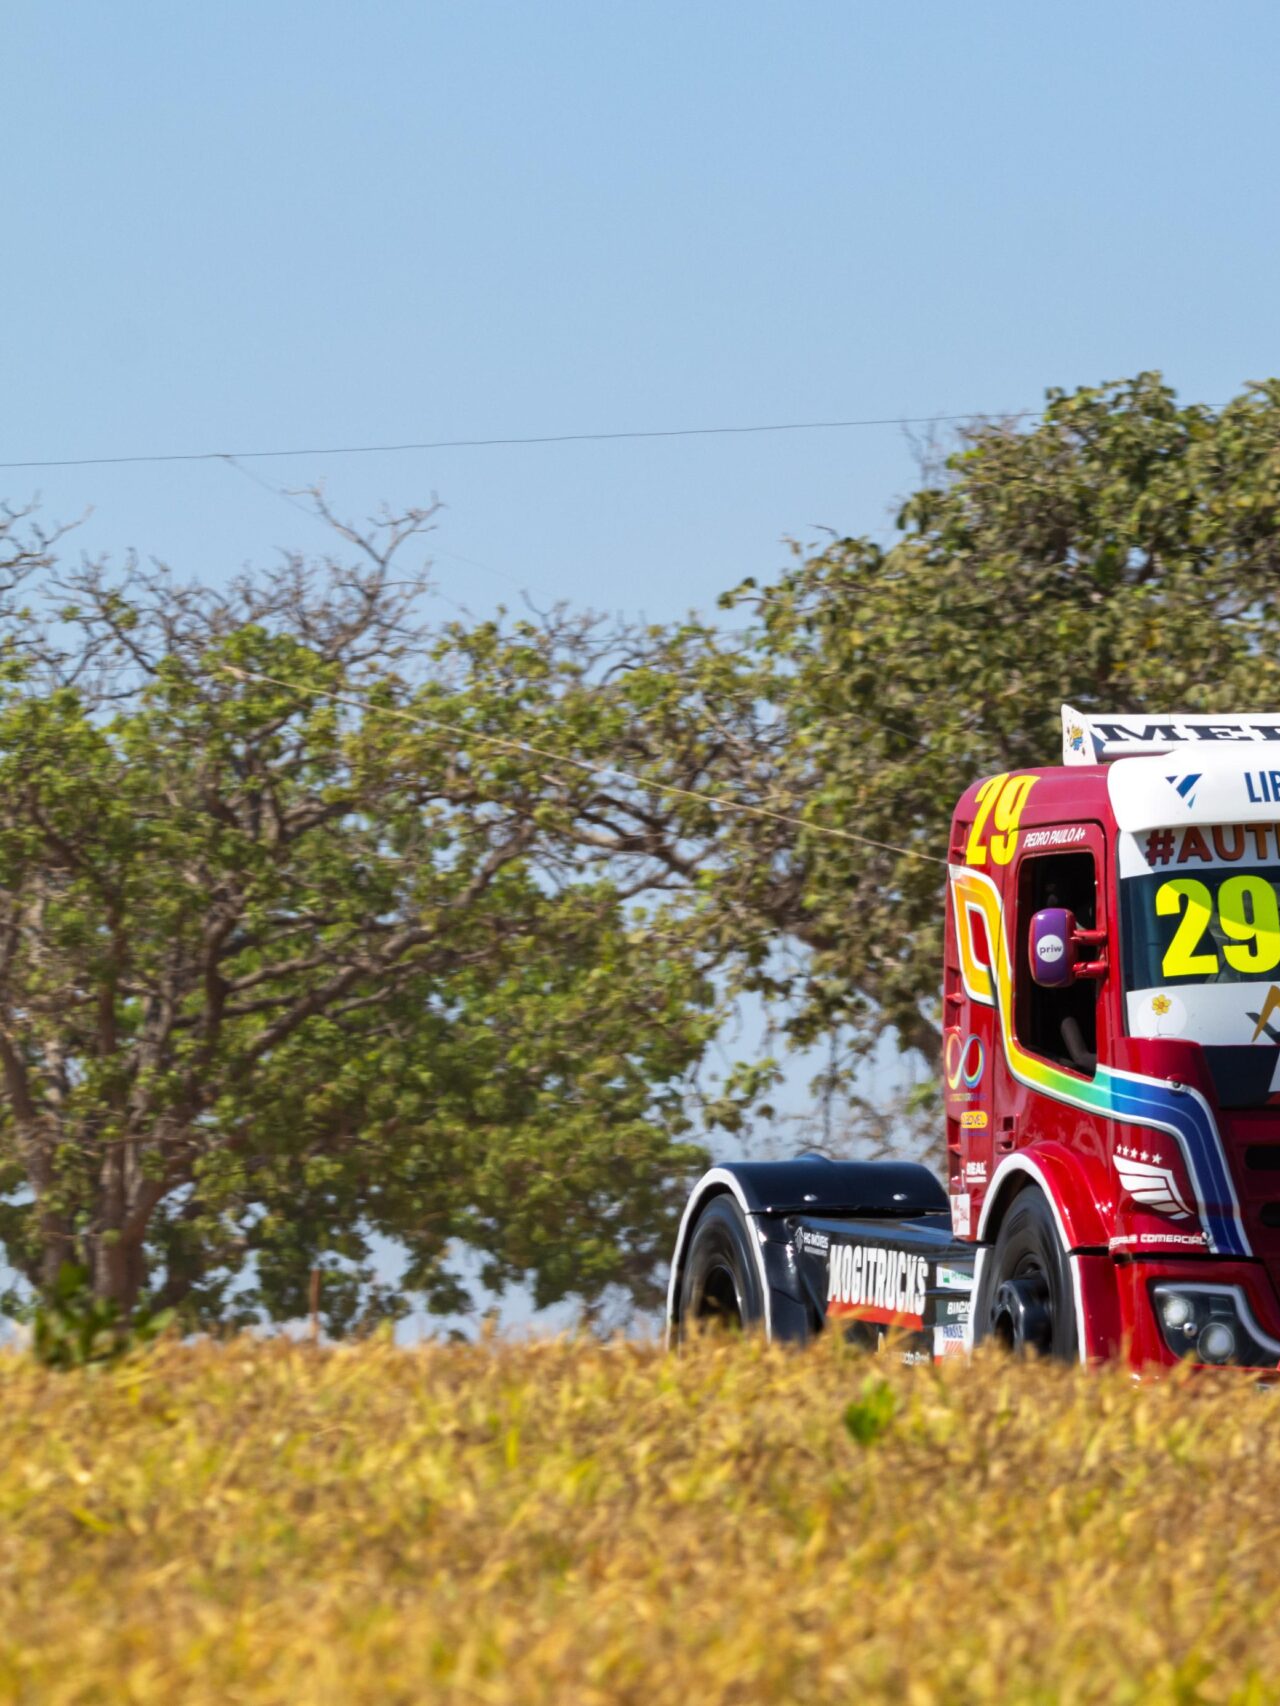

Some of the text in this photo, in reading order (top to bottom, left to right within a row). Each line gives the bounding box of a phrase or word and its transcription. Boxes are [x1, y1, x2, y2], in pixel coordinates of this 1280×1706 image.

[966, 772, 1041, 866] 29
[1023, 831, 1050, 848] PEDRO
[1048, 827, 1076, 844] PAULO
[1140, 1233, 1206, 1245] COMERCIAL
[827, 1244, 929, 1316] MOGITRUCKS
